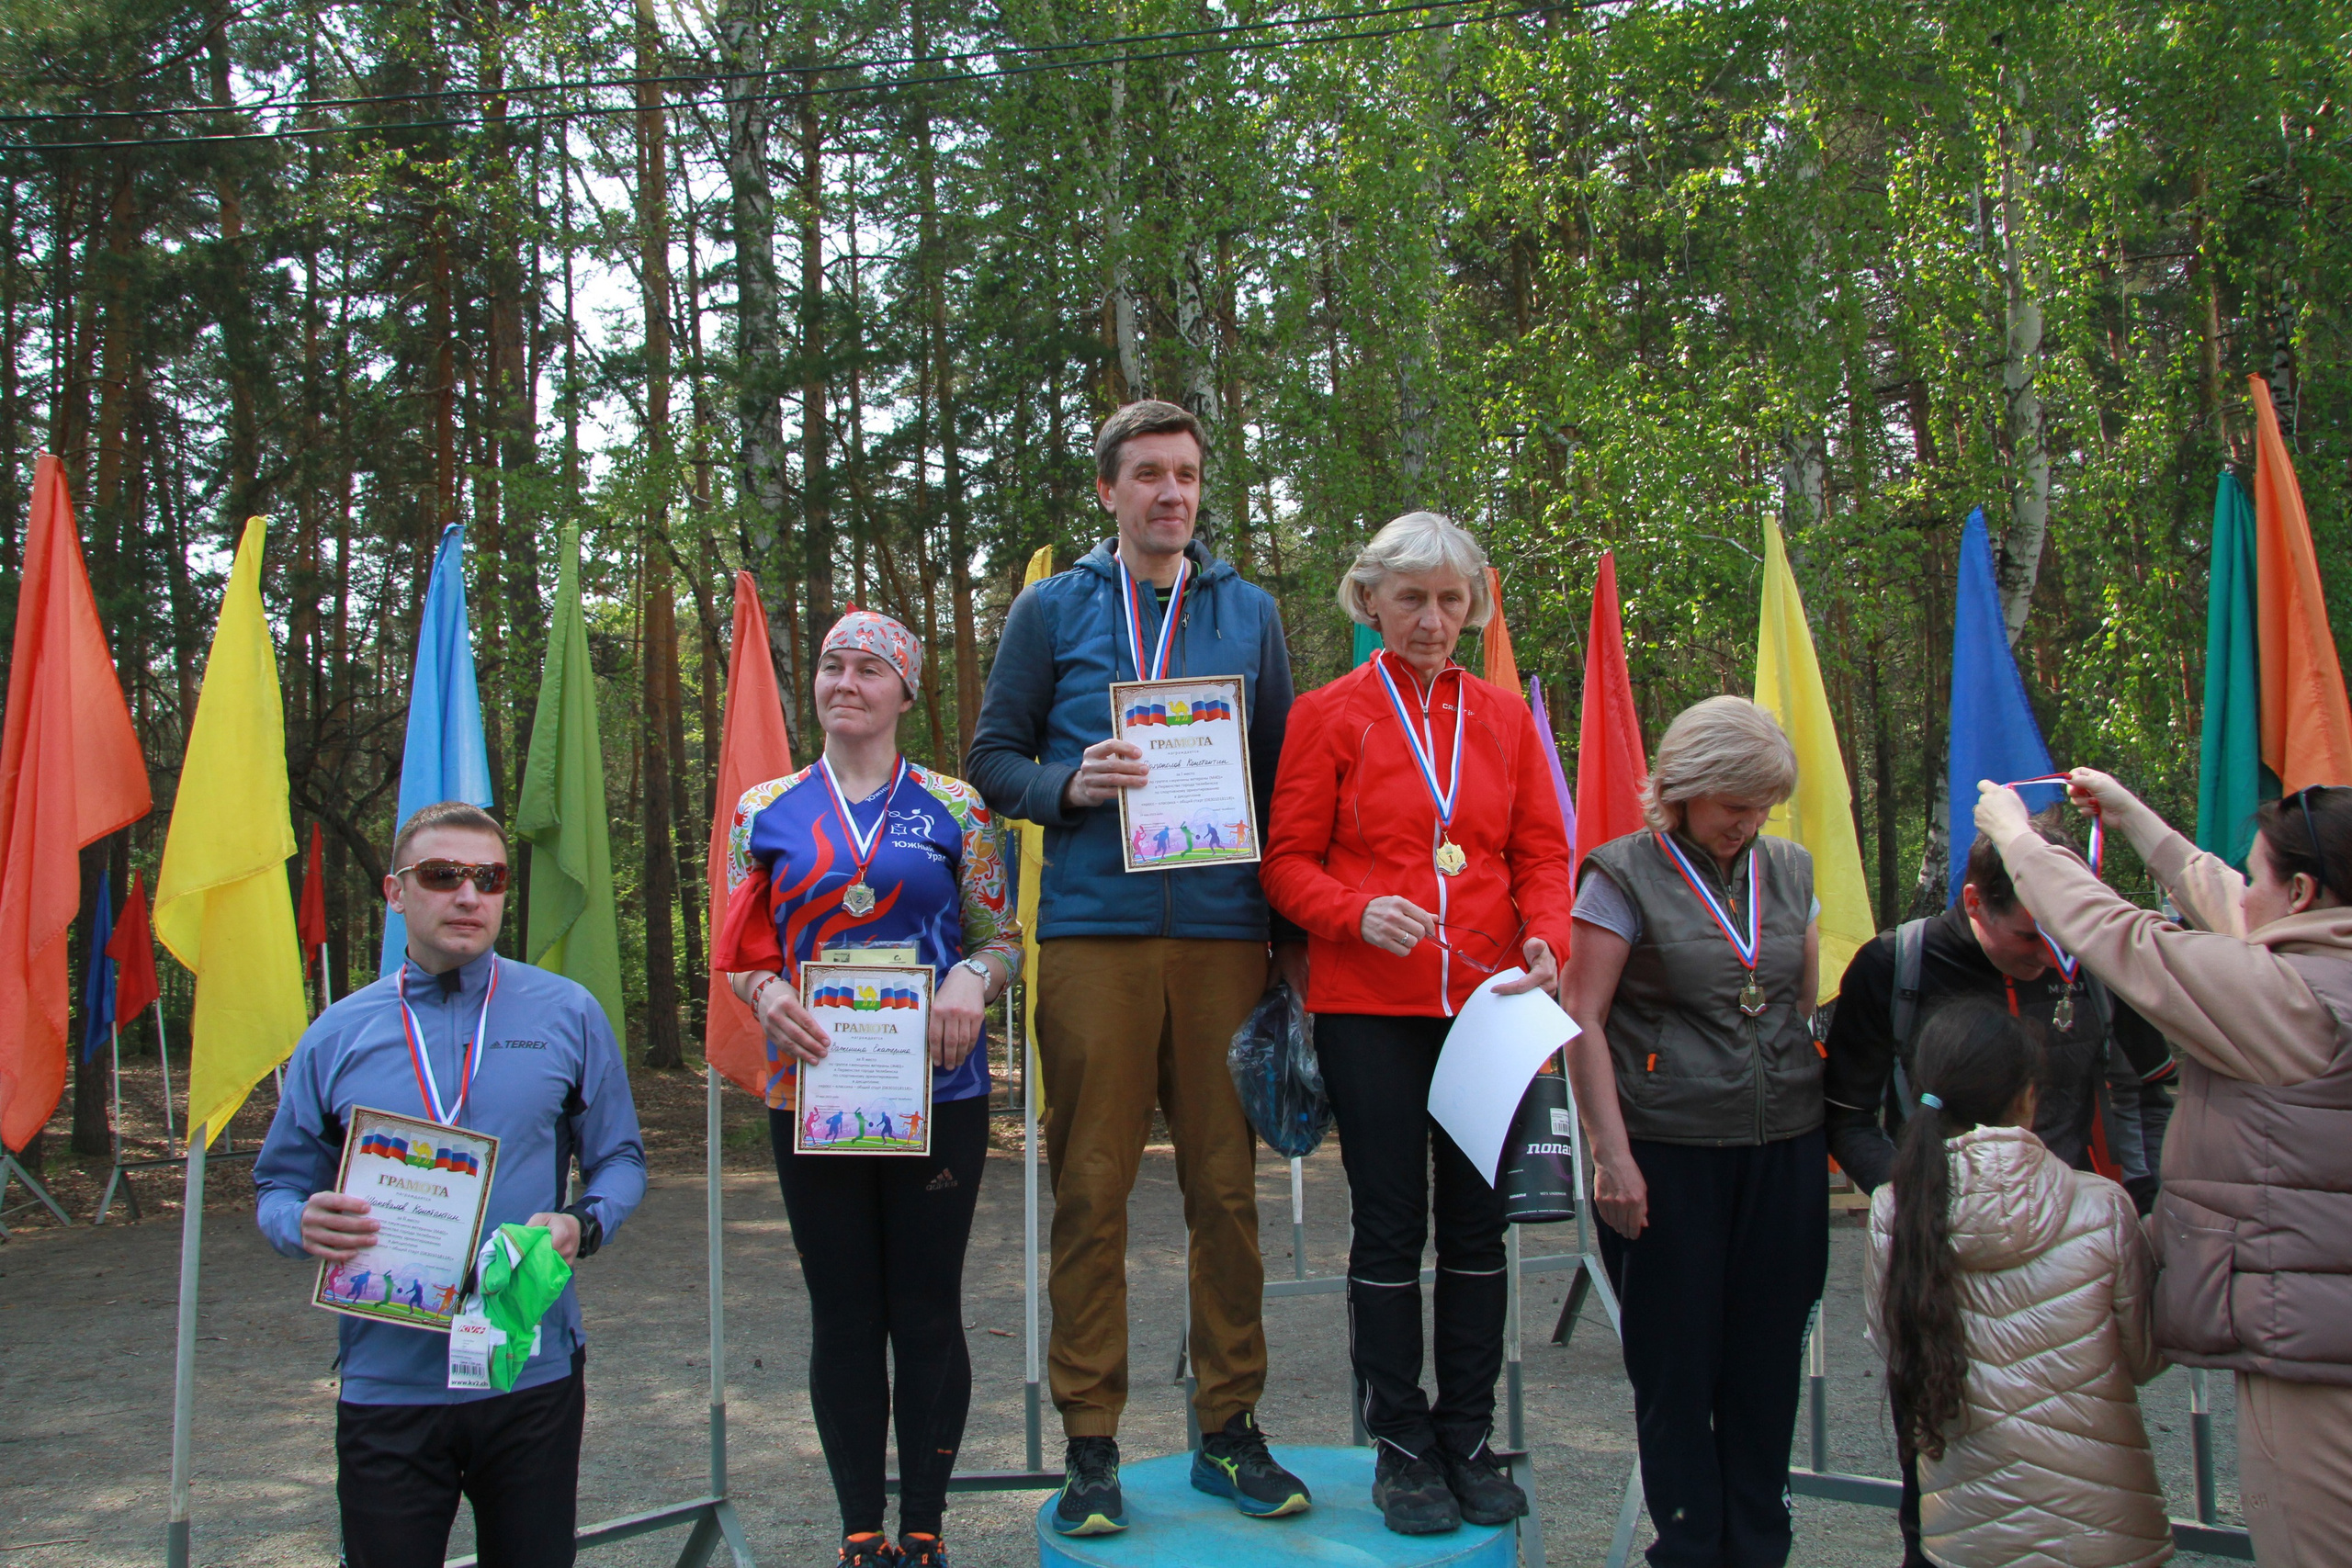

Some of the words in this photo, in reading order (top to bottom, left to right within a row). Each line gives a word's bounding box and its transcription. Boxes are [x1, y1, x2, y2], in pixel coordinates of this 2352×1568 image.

[1442, 703, 1467, 713] CRA
[1150, 737, 1213, 750] ГРАМОТА
[891, 840, 934, 852] Южный
[926, 851, 946, 863] Урал
[1448, 854, 1453, 863] 1
[855, 895, 863, 904] 2
[834, 1022, 899, 1034] ГРАМОТА
[504, 1040, 548, 1050] TERREX
[873, 1043, 910, 1055] Екатерина
[379, 1174, 449, 1197] ГРАМОТА
